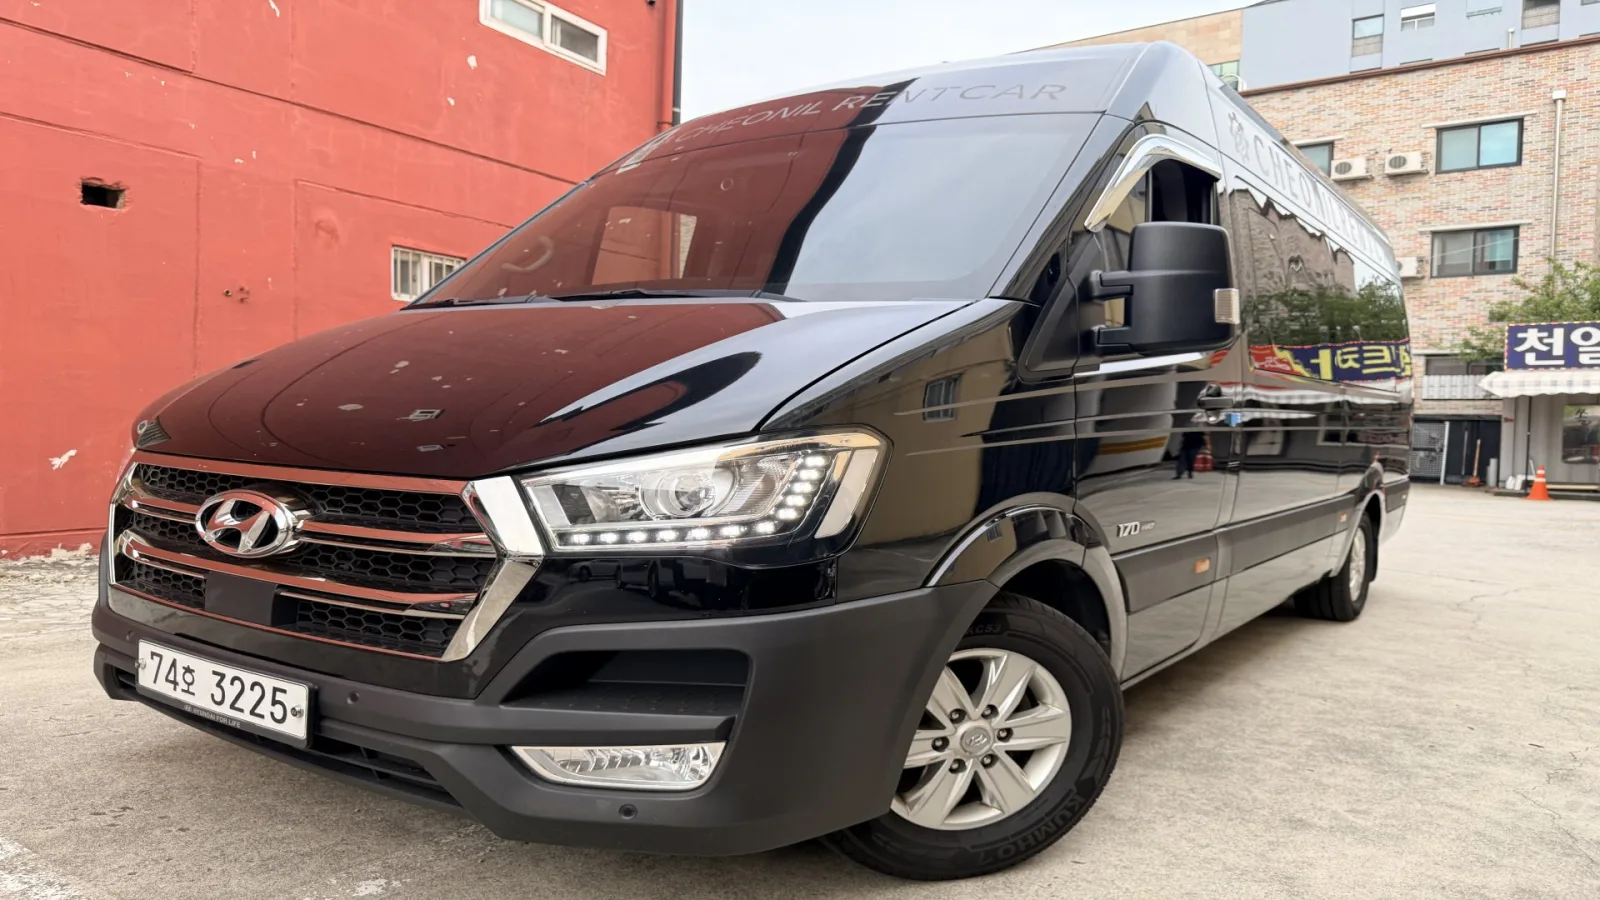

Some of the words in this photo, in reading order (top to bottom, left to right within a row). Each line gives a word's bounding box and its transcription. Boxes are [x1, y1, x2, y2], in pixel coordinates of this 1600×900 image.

[675, 100, 821, 143] CHEONIL
[832, 84, 1067, 112] RENTCAR
[1118, 521, 1140, 538] 170
[151, 652, 195, 695] 74호
[211, 670, 287, 724] 3225
[192, 708, 216, 720] HYUNDAI
[216, 715, 228, 724] FOR
[229, 718, 241, 728] LIFE
